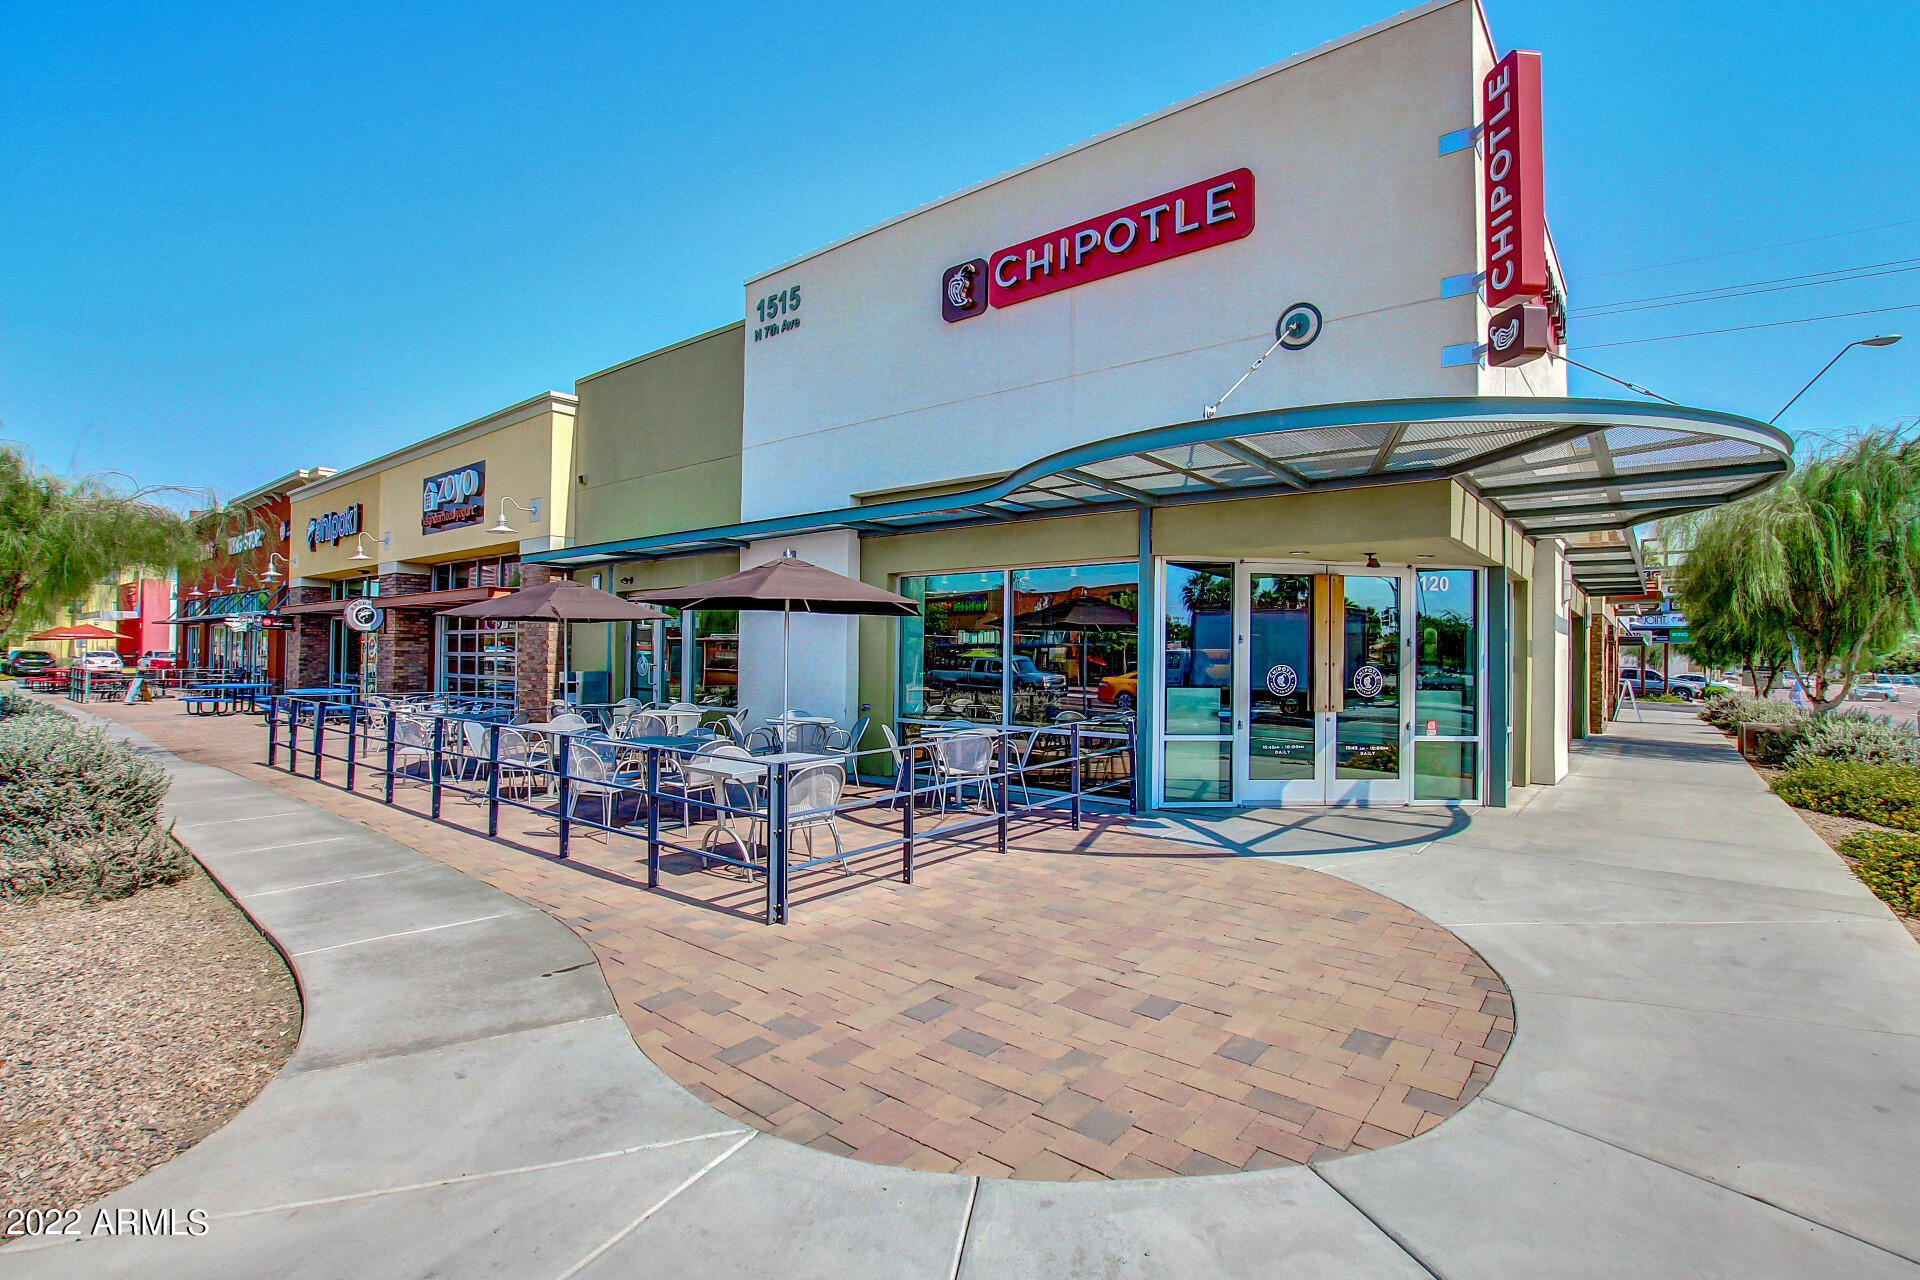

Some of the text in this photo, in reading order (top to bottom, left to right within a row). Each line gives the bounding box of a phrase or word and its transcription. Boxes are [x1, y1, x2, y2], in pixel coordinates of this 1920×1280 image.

[1488, 65, 1514, 290] CHIPOTLE
[994, 181, 1236, 289] CHIPOTLE
[756, 285, 801, 322] 1515
[754, 317, 801, 342] N 7th Ave
[1420, 576, 1449, 592] 120
[1269, 666, 1295, 679] CHIPOTLE
[1356, 668, 1381, 680] CHIPOTLE
